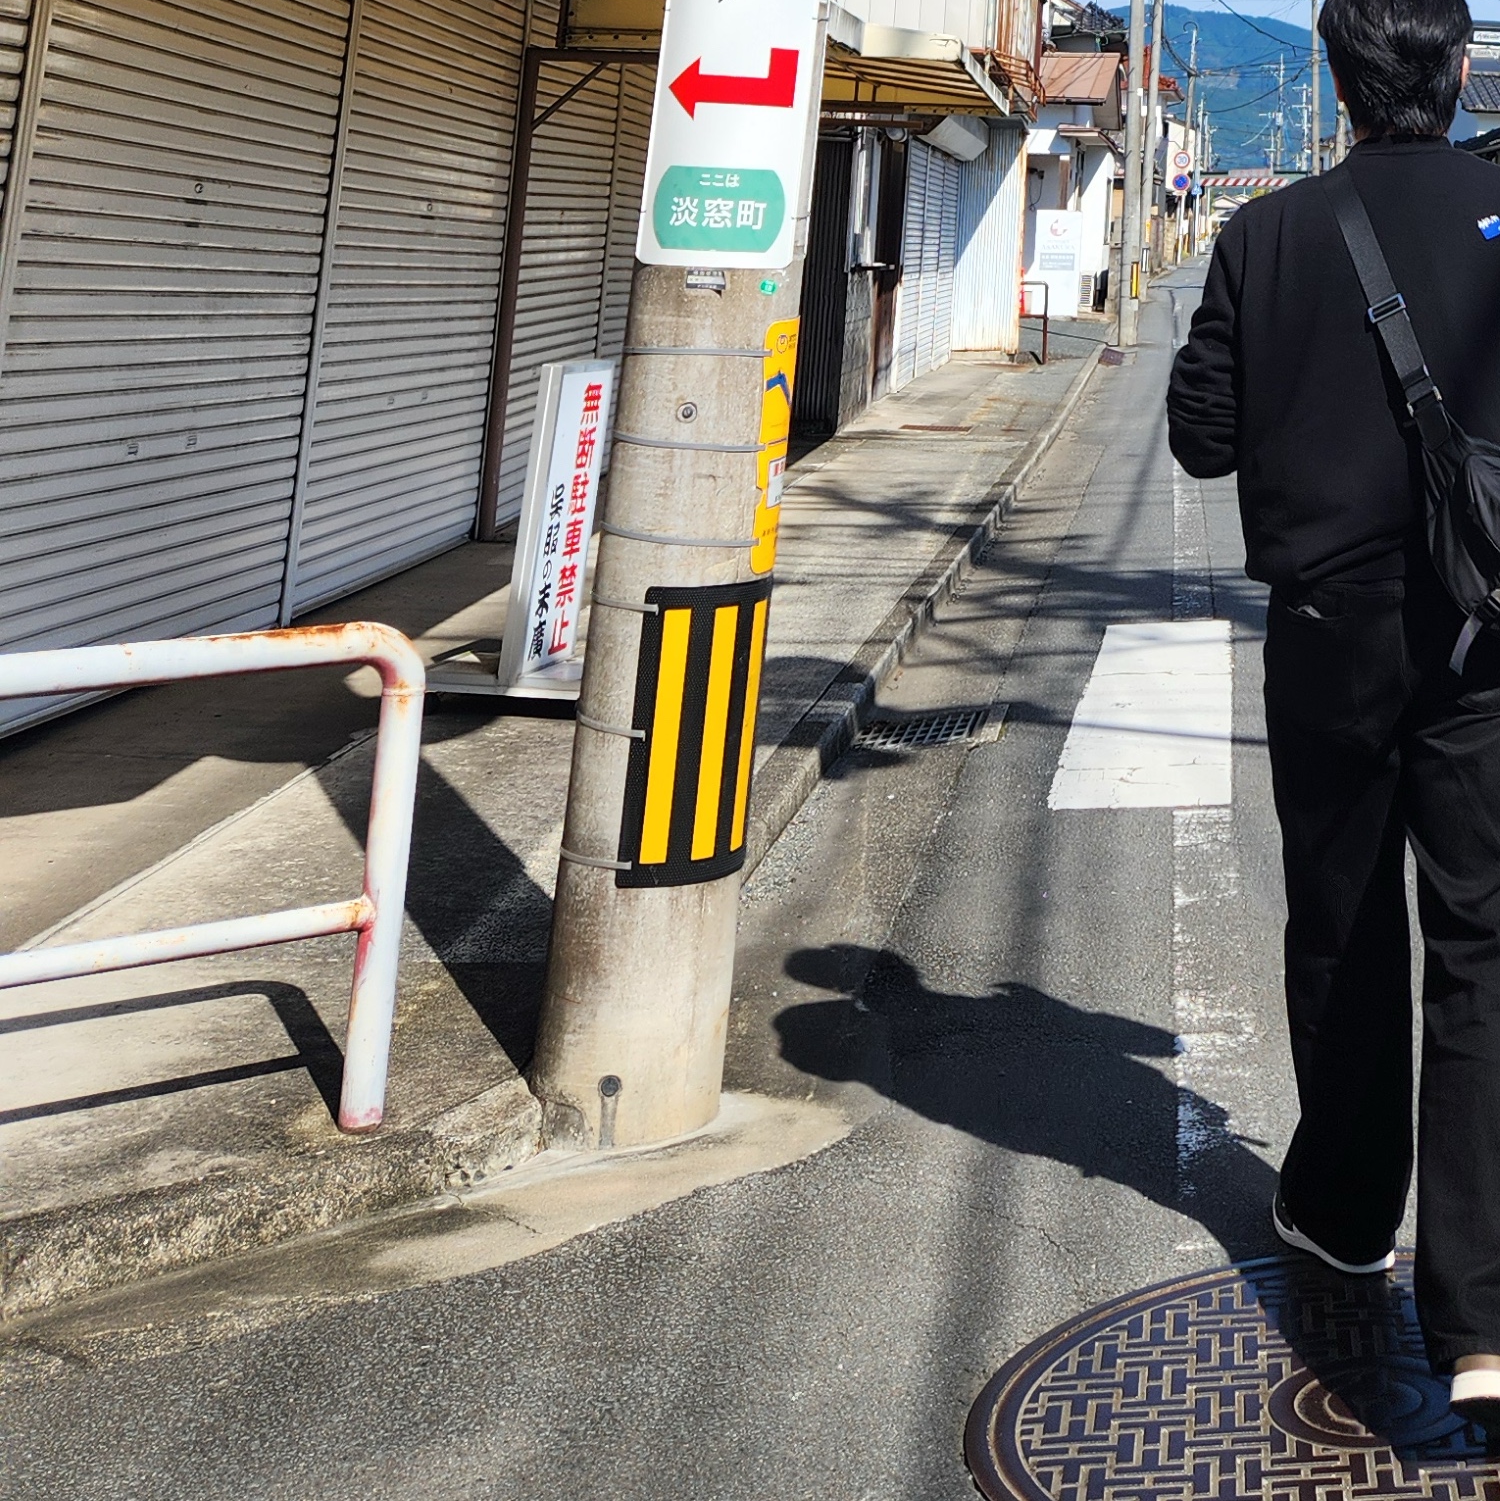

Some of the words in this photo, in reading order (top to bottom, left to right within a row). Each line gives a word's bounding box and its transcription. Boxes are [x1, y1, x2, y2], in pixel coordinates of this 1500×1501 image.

[699, 173, 740, 188] ここは
[669, 196, 767, 230] 淡窓町
[547, 382, 603, 655] 無断駐車禁止
